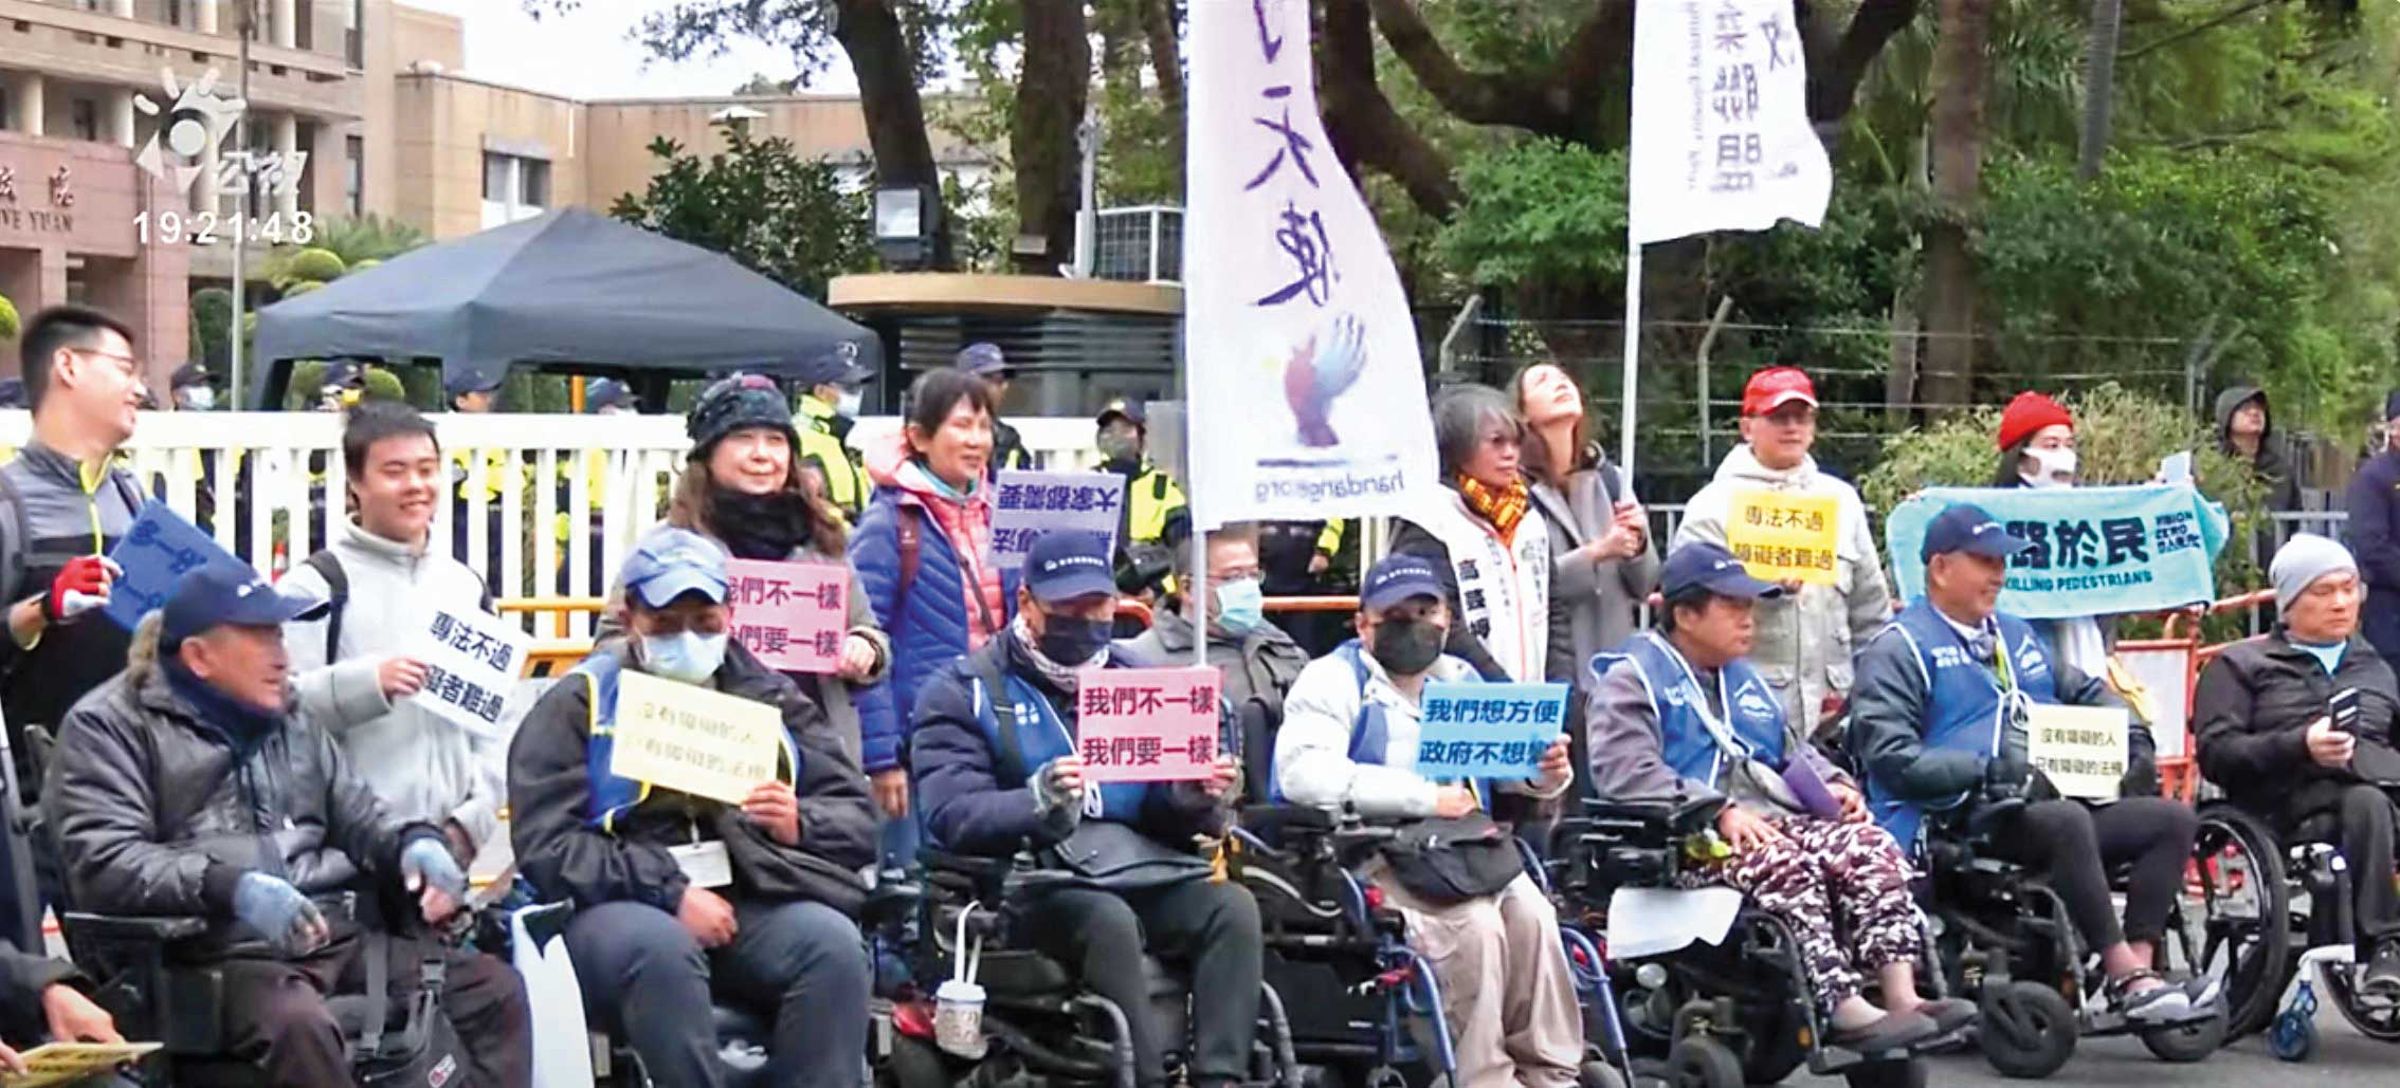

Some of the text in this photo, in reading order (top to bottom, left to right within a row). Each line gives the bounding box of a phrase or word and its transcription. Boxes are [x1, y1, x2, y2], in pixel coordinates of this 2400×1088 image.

[2057, 571, 2153, 591] PEDESTRIANS
[429, 609, 515, 673] 專法不過
[728, 624, 839, 658] 們要一樣
[423, 663, 505, 725] 礙者難過
[1084, 686, 1215, 716] 我們不一樣
[1425, 698, 1561, 724] 我們想方便
[1083, 737, 1214, 766] 我們要一樣
